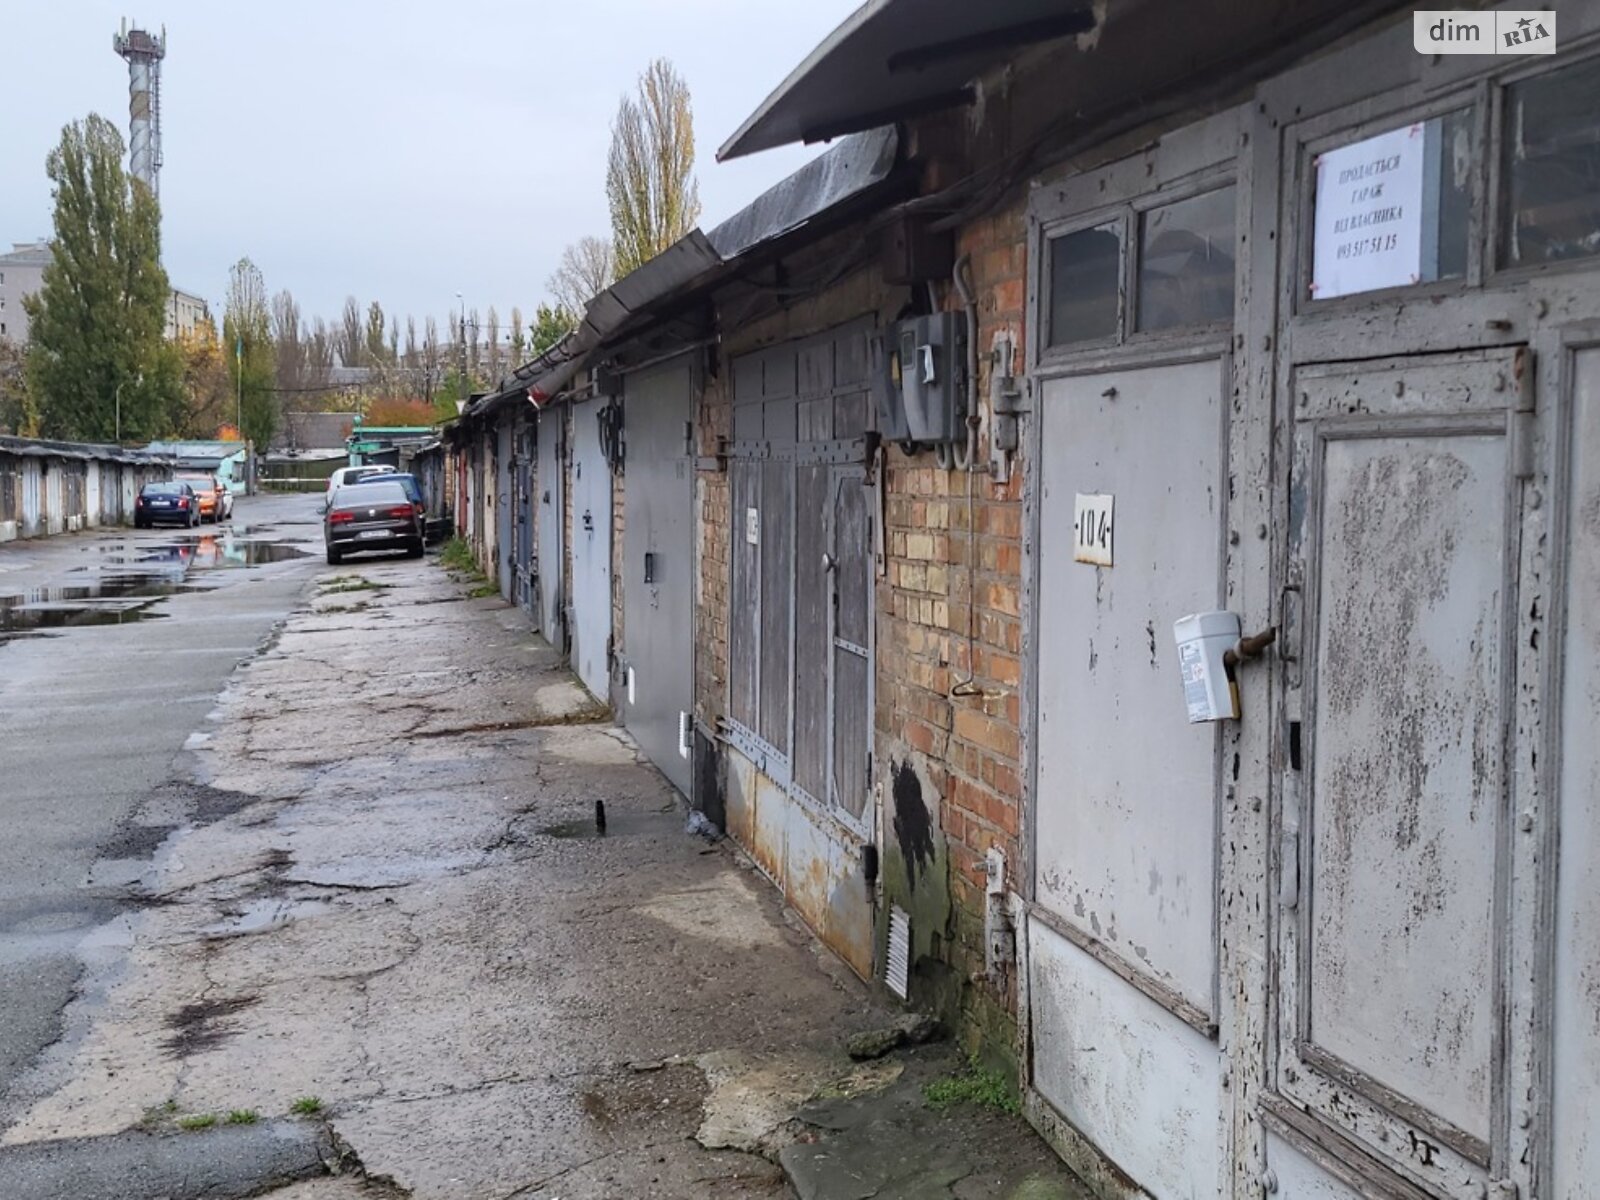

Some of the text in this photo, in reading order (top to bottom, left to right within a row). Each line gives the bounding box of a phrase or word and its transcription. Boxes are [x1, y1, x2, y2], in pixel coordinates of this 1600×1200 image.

[1351, 183, 1385, 204] ГАРАЖ
[1350, 205, 1403, 230] ВЛАСНИКА
[1384, 233, 1397, 250] 15
